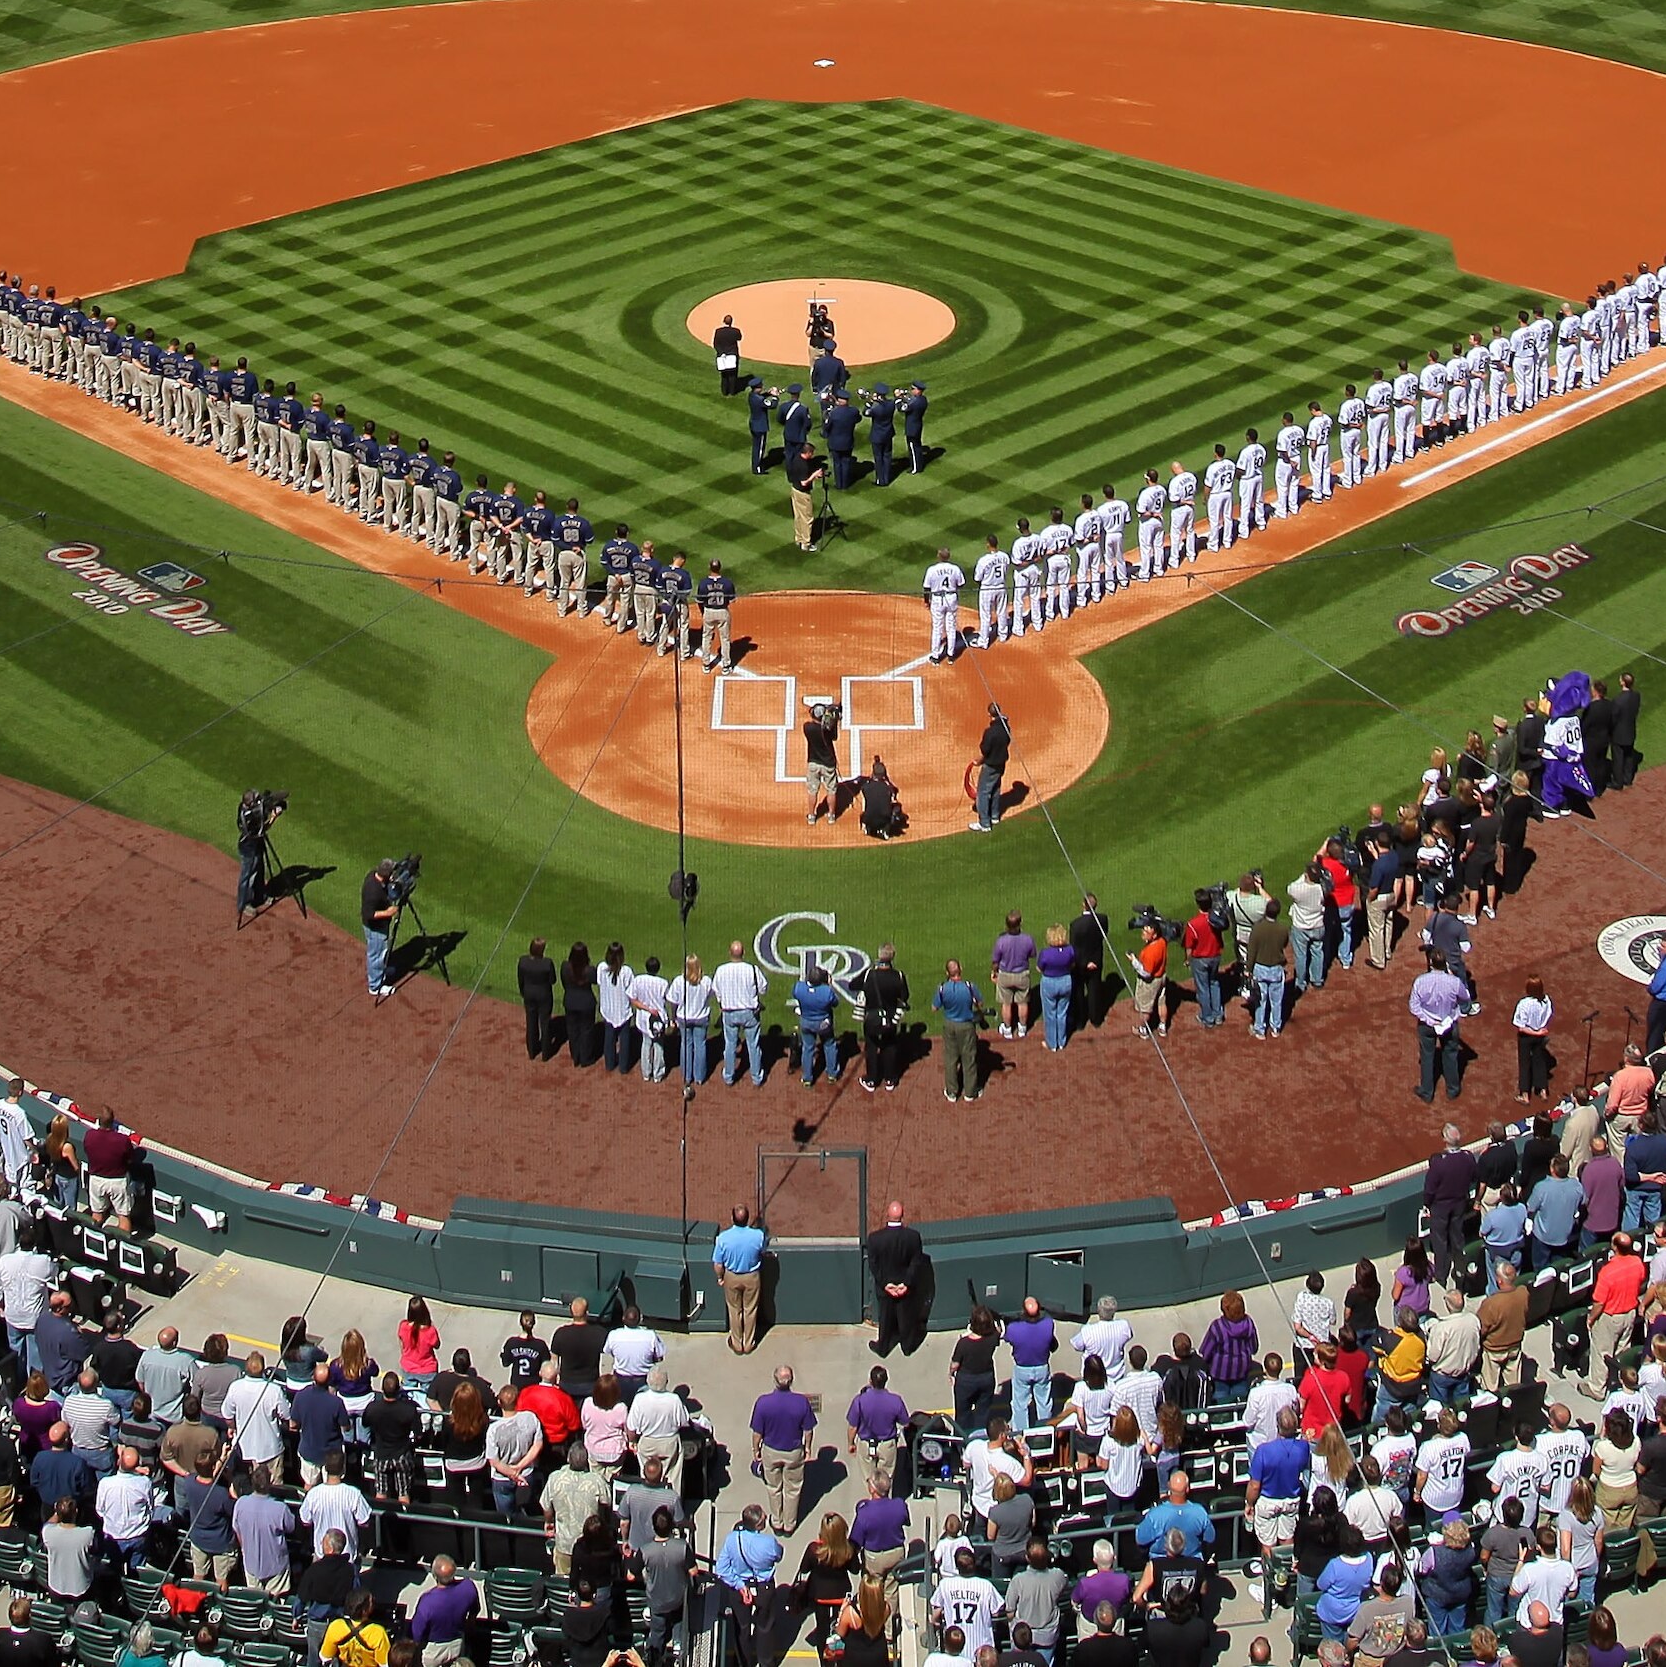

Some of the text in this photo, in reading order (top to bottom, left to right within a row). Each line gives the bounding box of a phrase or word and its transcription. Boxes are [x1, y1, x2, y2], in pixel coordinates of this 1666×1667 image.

[994, 565, 1003, 578] 5
[46, 541, 230, 635] OPENING DAY
[1398, 543, 1590, 636] OPENING DAY
[71, 589, 130, 615] 2010
[1509, 587, 1563, 615] 2010
[1566, 727, 1580, 744] 00
[1603, 916, 1655, 956] COORS FIELD
[518, 1358, 530, 1375] 2
[1546, 1444, 1580, 1459] CORPAS
[1441, 1458, 1462, 1480] 17
[1518, 1479, 1531, 1497] 2
[950, 1590, 982, 1601] HELTON
[953, 1603, 978, 1624] 17
